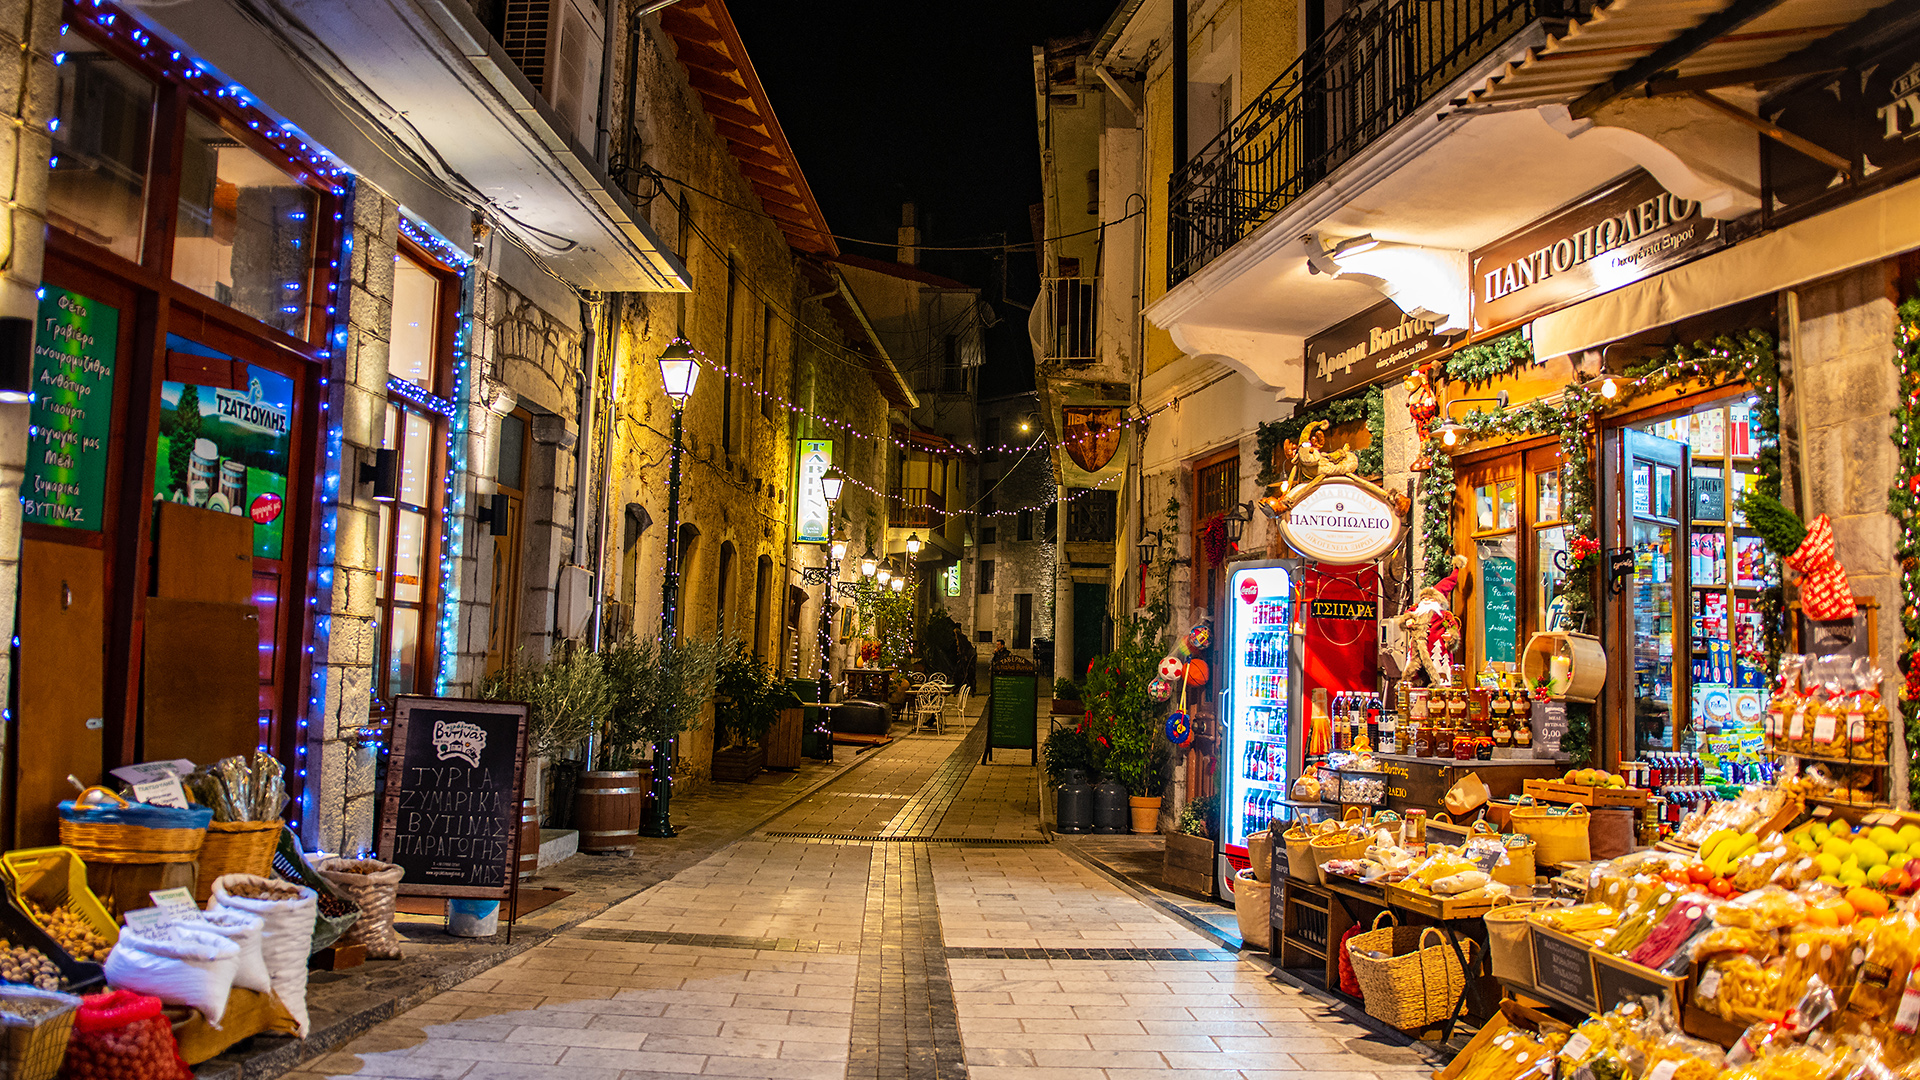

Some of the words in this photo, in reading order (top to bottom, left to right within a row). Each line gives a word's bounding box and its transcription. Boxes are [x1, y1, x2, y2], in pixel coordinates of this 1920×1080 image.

[1484, 193, 1699, 303] ΠΑΝΤΟΠΩΛΕΙΟ
[1661, 225, 1696, 250] Ξηρού
[57, 295, 87, 317] Φέτα
[45, 318, 94, 349] Γραβιέρα
[1368, 313, 1435, 355] Βυτίνας
[40, 369, 91, 401] Ανθότυρο
[42, 396, 85, 424] Γιαούρτι
[213, 393, 286, 433] ΤΣΑΤΣΟΥΛΗΣ
[83, 436, 100, 453] μας
[45, 450, 74, 469] Μέλι
[25, 499, 84, 521] ΒΥΤΙΝΑΣ
[1290, 514, 1389, 530] ΠΑΝΤΟΠΩΛΕΙΟ
[1305, 533, 1349, 551] ΟΙΚΟΓΕΝΕΙΑ
[1350, 537, 1375, 551] ΞΗΡΟΥ
[1313, 602, 1374, 618] ΤΣΙΓΑΡΑ
[1542, 727, 1561, 740] 9,00
[411, 767, 493, 790] ΤΥΡΙΑ
[400, 789, 502, 813] ΖΥΜΑΡΙΚΑ
[408, 812, 505, 838] ΒΥΤΙΝΑΣ
[396, 834, 505, 861] ΠΑΡΑΓΩΓΗΣ
[468, 864, 502, 884] ΜΑΣ
